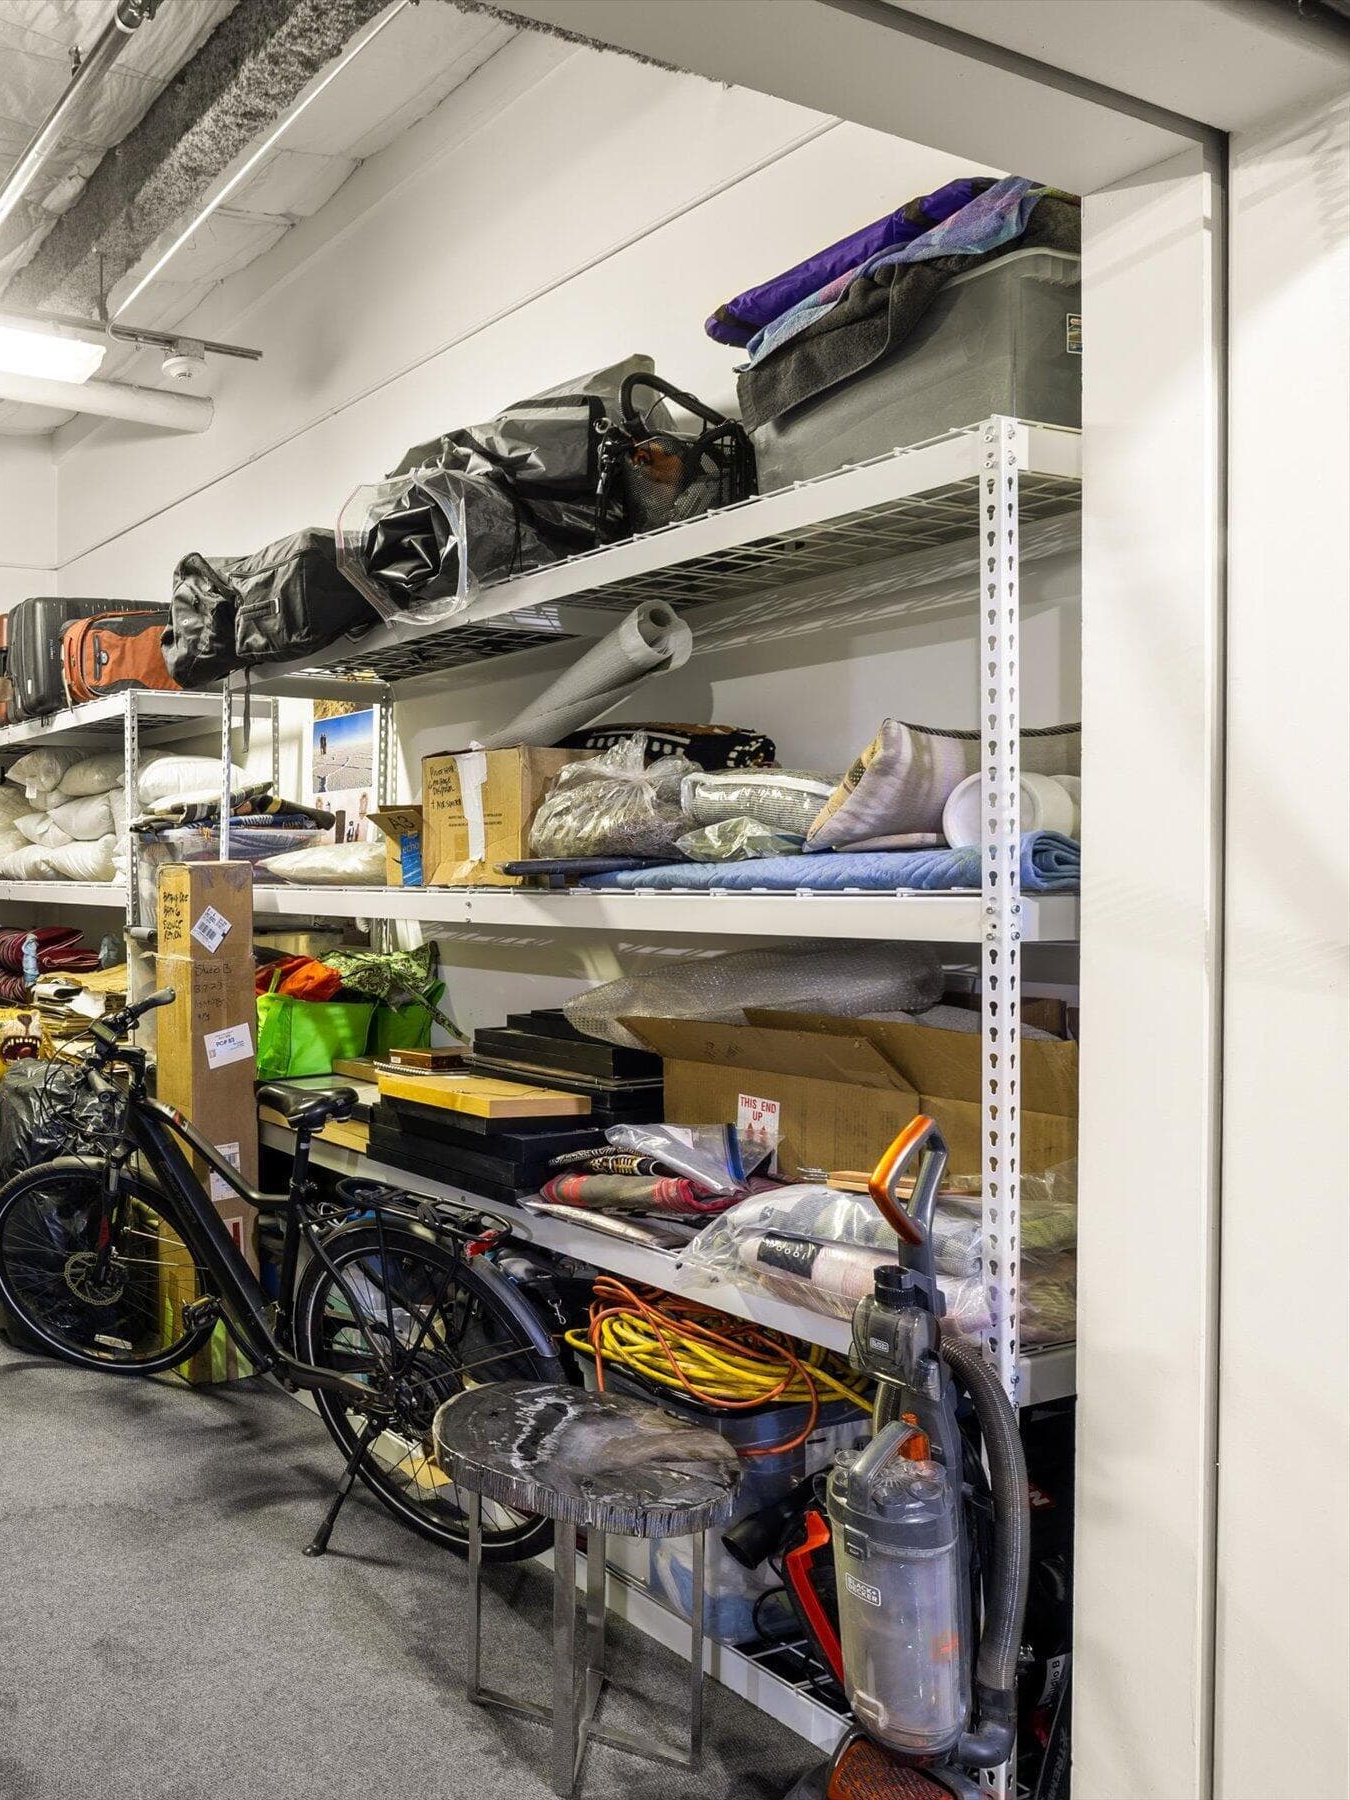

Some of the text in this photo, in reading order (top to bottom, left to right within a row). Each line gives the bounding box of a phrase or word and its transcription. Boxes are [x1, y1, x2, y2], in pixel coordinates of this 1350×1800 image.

[740, 1096, 777, 1114] THIS END
[752, 1110, 763, 1121] UP
